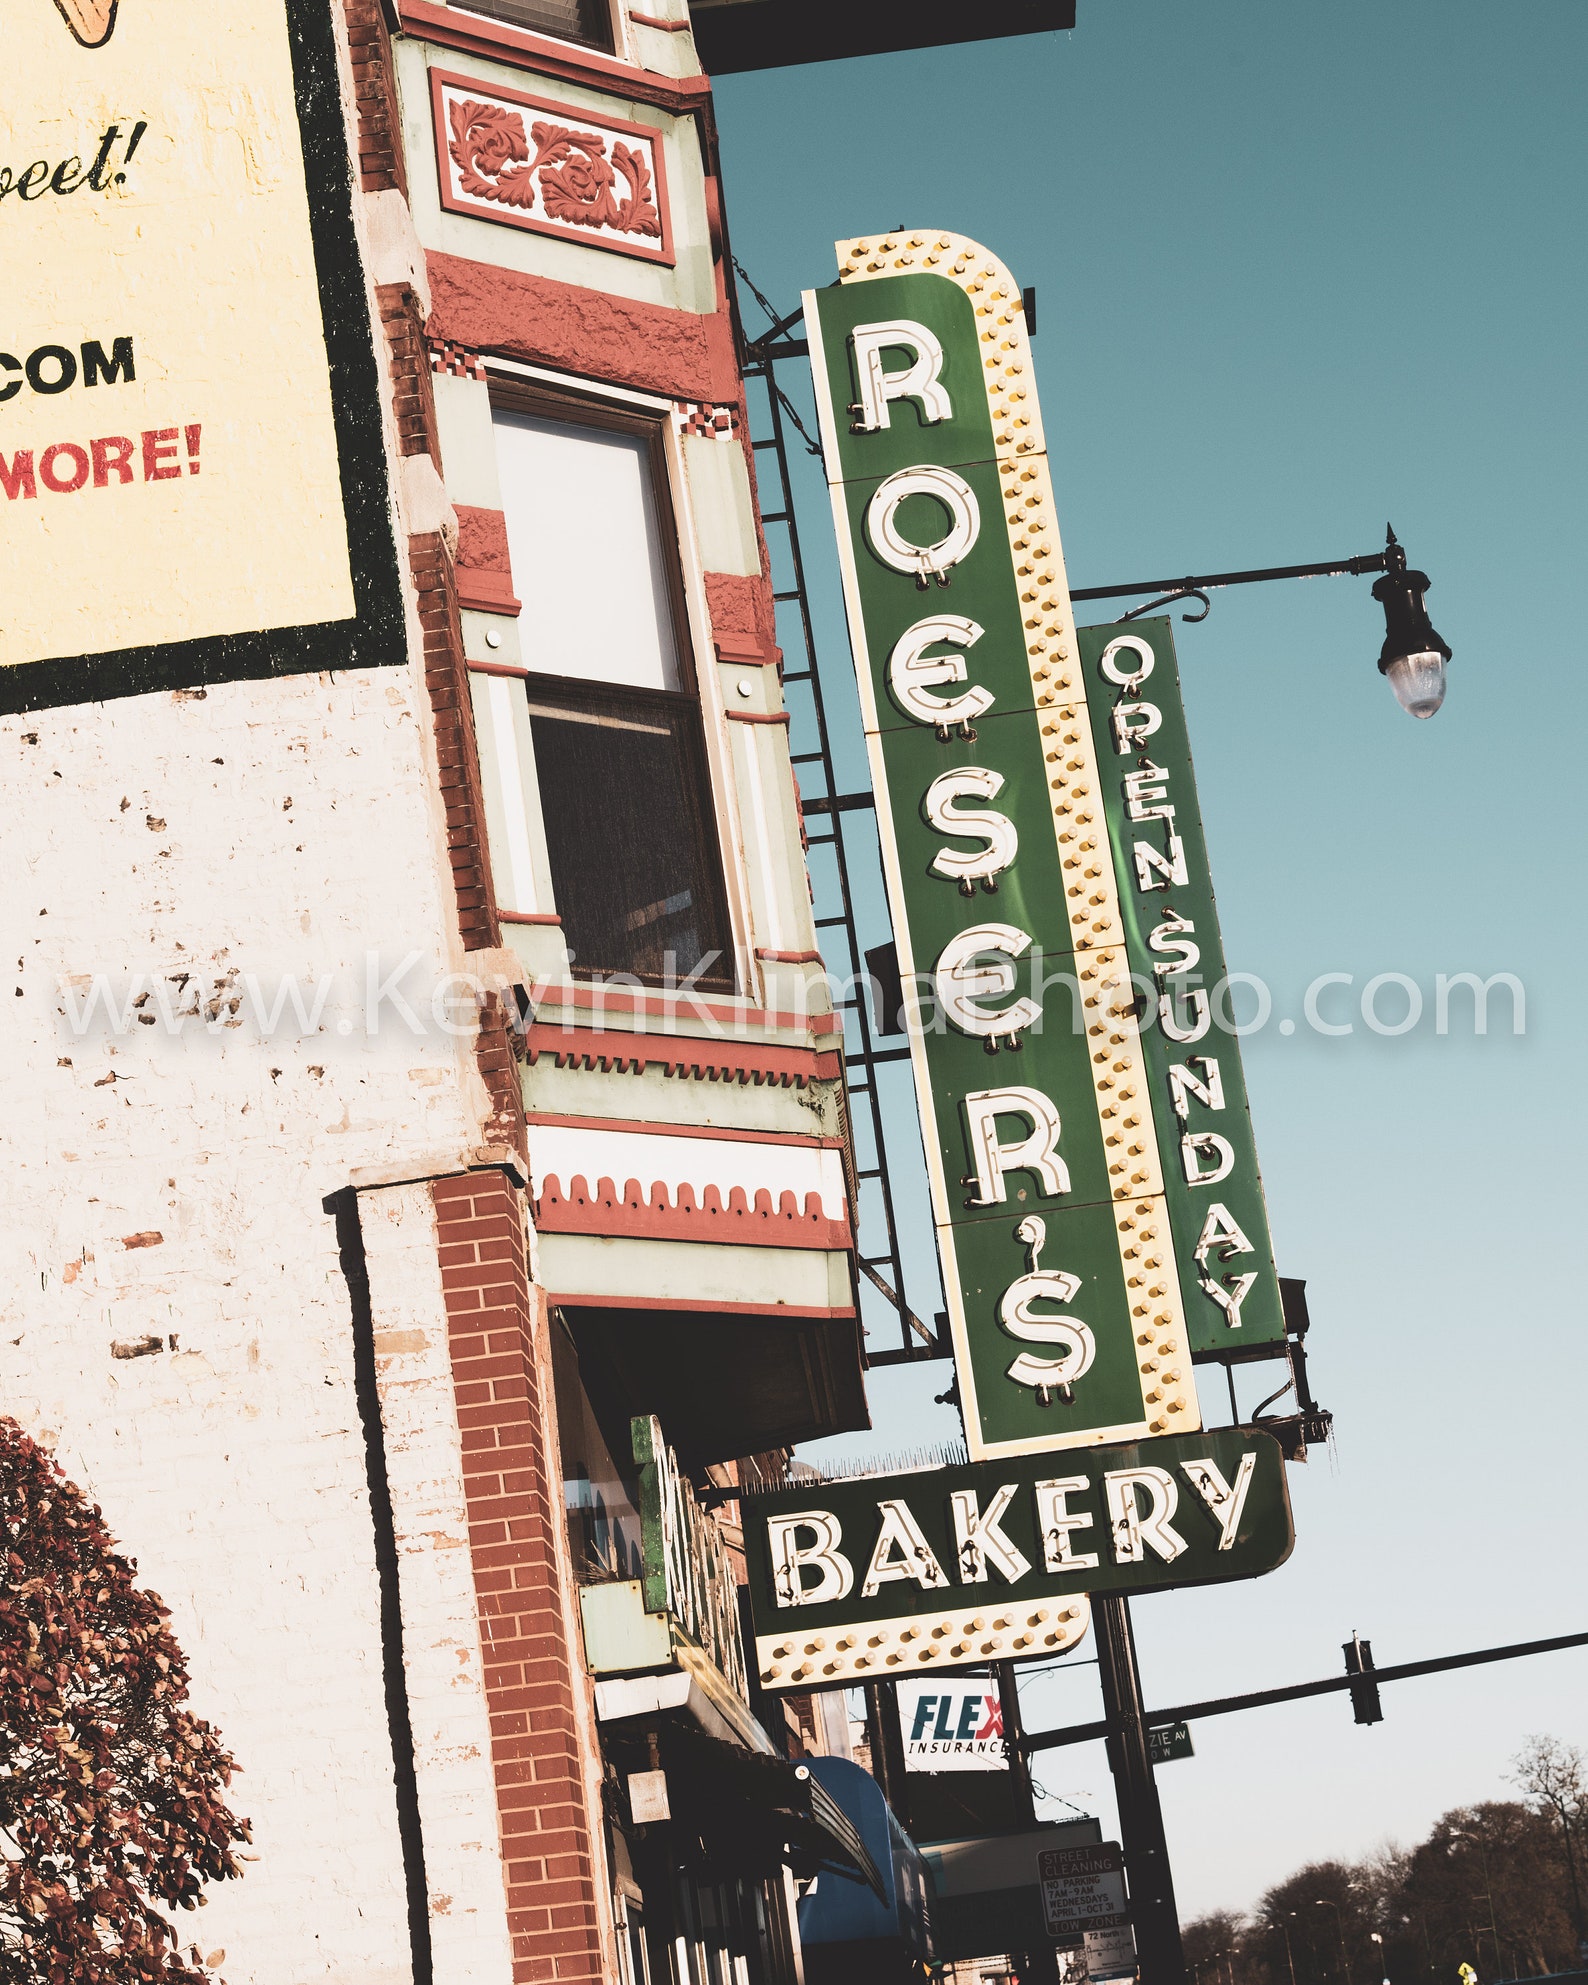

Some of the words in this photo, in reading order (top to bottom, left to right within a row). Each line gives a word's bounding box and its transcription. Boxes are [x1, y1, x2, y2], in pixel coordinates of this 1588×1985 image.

[0, 424, 202, 500] MORE!
[1101, 635, 1190, 892] OPEN
[1149, 920, 1258, 1329] SUNDAY
[767, 1452, 1256, 1607] BAKERY
[910, 1695, 1004, 1740] FLEX
[1175, 1730, 1186, 1741] AV
[1162, 1747, 1171, 1757] W
[1044, 1849, 1091, 1865] STREET
[1045, 1858, 1112, 1876] CLEANING
[1047, 1880, 1058, 1890] NO
[1064, 1876, 1101, 1888] PARKING
[1049, 1894, 1109, 1908] WEDNESDAYS
[1051, 1906, 1076, 1919] APRIL
[1106, 1902, 1114, 1912] 31
[1053, 1919, 1080, 1933] TOW
[1088, 1915, 1123, 1930] ZONE
[1088, 1932, 1098, 1941] 72
[1100, 1930, 1120, 1939] North
